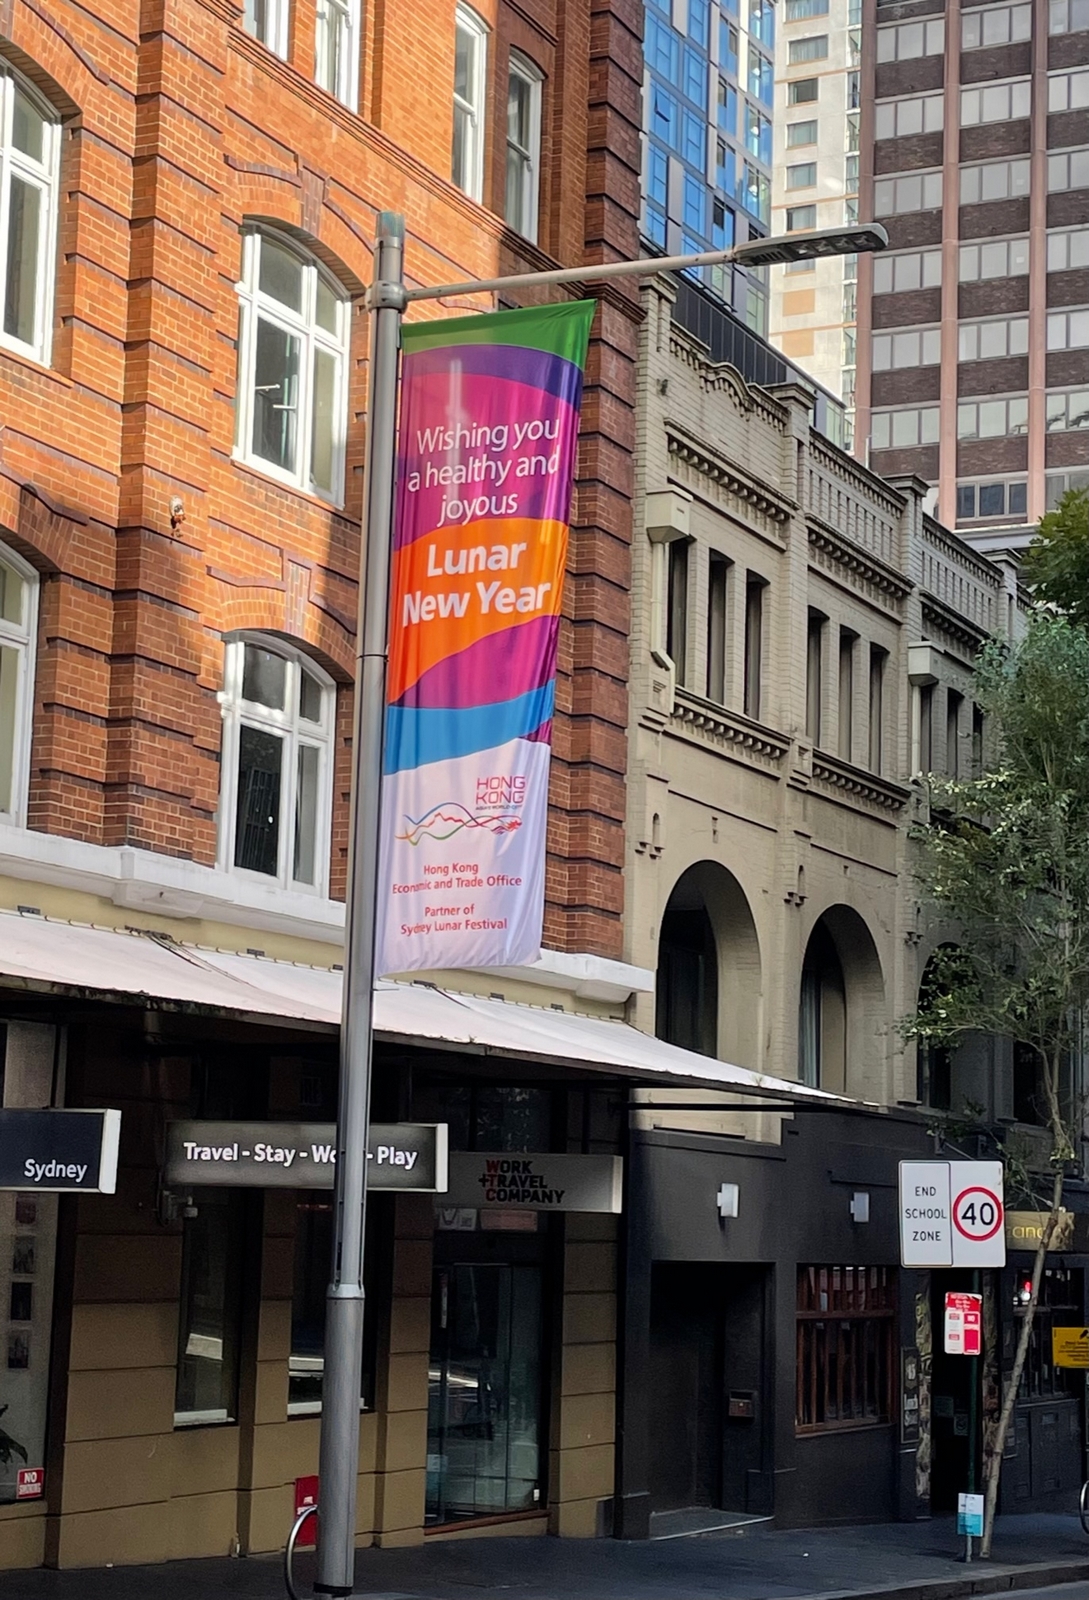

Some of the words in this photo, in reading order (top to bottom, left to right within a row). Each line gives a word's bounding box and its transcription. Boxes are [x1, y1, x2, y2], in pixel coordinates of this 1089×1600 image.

[417, 422, 508, 454] Wishing
[513, 419, 560, 450] you
[408, 472, 420, 492] a
[426, 454, 512, 487] healthy
[516, 445, 560, 478] and
[437, 494, 518, 527] joyous
[426, 542, 527, 577] Lunar
[402, 591, 470, 628] New
[476, 581, 551, 614] Year
[477, 776, 526, 790] HONG
[476, 790, 524, 804] KONG
[424, 864, 449, 876] Hong
[452, 862, 478, 874] Kong
[434, 878, 452, 889] and
[456, 876, 483, 888] Trade
[486, 874, 522, 886] Office
[424, 906, 460, 917] Partner
[463, 903, 474, 915] of
[401, 922, 432, 936] Sydey
[434, 921, 462, 932] Lunar
[465, 918, 508, 930] Festival
[183, 1142, 238, 1161] Travel
[254, 1144, 296, 1167] Stay
[378, 1146, 418, 1170] Play
[24, 1159, 88, 1182] Sydney
[486, 1160, 533, 1174] WORK
[486, 1188, 565, 1204] COMPANY
[914, 1186, 936, 1197] END
[905, 1208, 948, 1219] SCHOOL
[962, 1202, 995, 1226] 40
[912, 1230, 942, 1242] ZONE
[24, 1472, 38, 1484] NO
